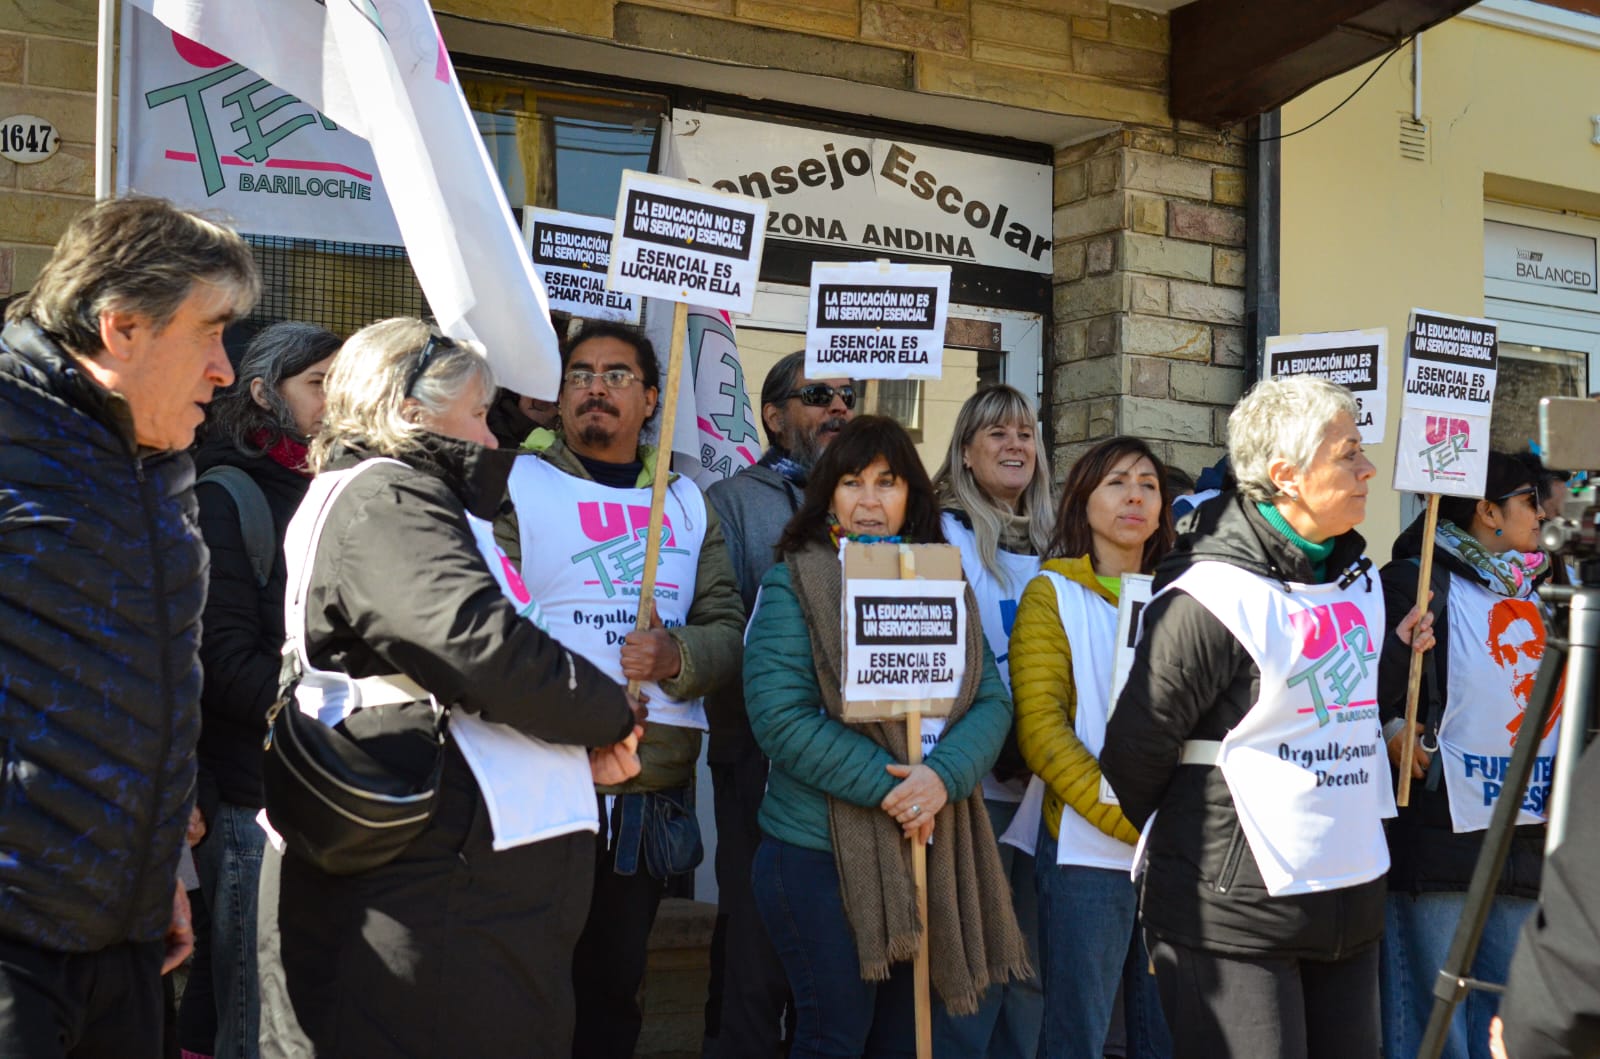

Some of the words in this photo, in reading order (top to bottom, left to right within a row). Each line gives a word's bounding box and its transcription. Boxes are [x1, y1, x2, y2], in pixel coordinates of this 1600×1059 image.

[0, 124, 52, 152] 1647
[238, 173, 372, 200] BARILOCHE
[688, 143, 871, 199] nsejo
[880, 143, 1052, 261] Escolar
[634, 200, 648, 216] LA
[650, 202, 714, 228] EDUCACIÓN
[715, 214, 730, 230] NO
[732, 218, 746, 234] ES
[541, 229, 552, 244] LA
[554, 232, 608, 252] EDUCACIÓN
[633, 216, 649, 232] UN
[650, 220, 696, 240] SERVICIO
[696, 228, 742, 250] ESENCIAL
[766, 211, 848, 241] ZONA
[862, 224, 976, 258] ANDINA
[540, 244, 553, 258] UN
[554, 245, 594, 264] SERVICIO
[637, 248, 708, 274] ESENCIAL
[714, 262, 732, 279] ES
[544, 272, 605, 292] ESENCIAL
[620, 261, 676, 284] LUCHAR
[678, 272, 706, 290] POR
[709, 278, 741, 297] ELLA
[1516, 262, 1592, 286] BALANCED
[548, 286, 580, 303] CHAR
[582, 290, 604, 306] POR
[606, 295, 632, 311] ELLA
[825, 291, 838, 306] LA
[840, 290, 898, 307] EDUCACIÓN
[900, 293, 914, 306] NO
[916, 294, 929, 307] ES
[825, 306, 838, 320] UN
[840, 307, 882, 320] SERVICIO
[884, 308, 928, 322] ESENCIAL
[830, 335, 896, 349] ESENCIAL
[902, 336, 918, 349] ES
[1416, 321, 1426, 336] LA
[1428, 324, 1470, 343] EDUCACIÓN
[1471, 330, 1482, 344] NO
[1483, 332, 1494, 346] ES
[817, 350, 867, 363] LUCHAR
[870, 350, 896, 364] POR
[898, 351, 928, 364] ELLA
[1415, 336, 1426, 350] UN
[1426, 338, 1459, 356] SERVICIO
[1459, 344, 1492, 360] ESENCIAL
[1277, 360, 1290, 374] LA
[1292, 353, 1342, 373] EDUCACIÓN
[1344, 354, 1358, 368] NO
[1360, 353, 1372, 368] ES
[1417, 366, 1468, 386] ESENCIAL
[1472, 374, 1485, 388] ES
[1406, 380, 1446, 398] LUCHAR
[1448, 385, 1466, 400] POR
[1468, 388, 1490, 404] ELLA
[862, 604, 876, 620] LA
[878, 601, 928, 620] EDUCACIÓN
[930, 604, 941, 620] NO
[942, 605, 952, 620] ES
[864, 621, 877, 636] UN
[878, 622, 920, 636] SERVICIO
[920, 622, 952, 636] ESENCIAL
[870, 652, 930, 668] ESENCIAL
[933, 652, 946, 667] ES
[857, 670, 909, 684] LUCHAR
[912, 669, 930, 684] POR
[931, 668, 954, 682] ELLA
